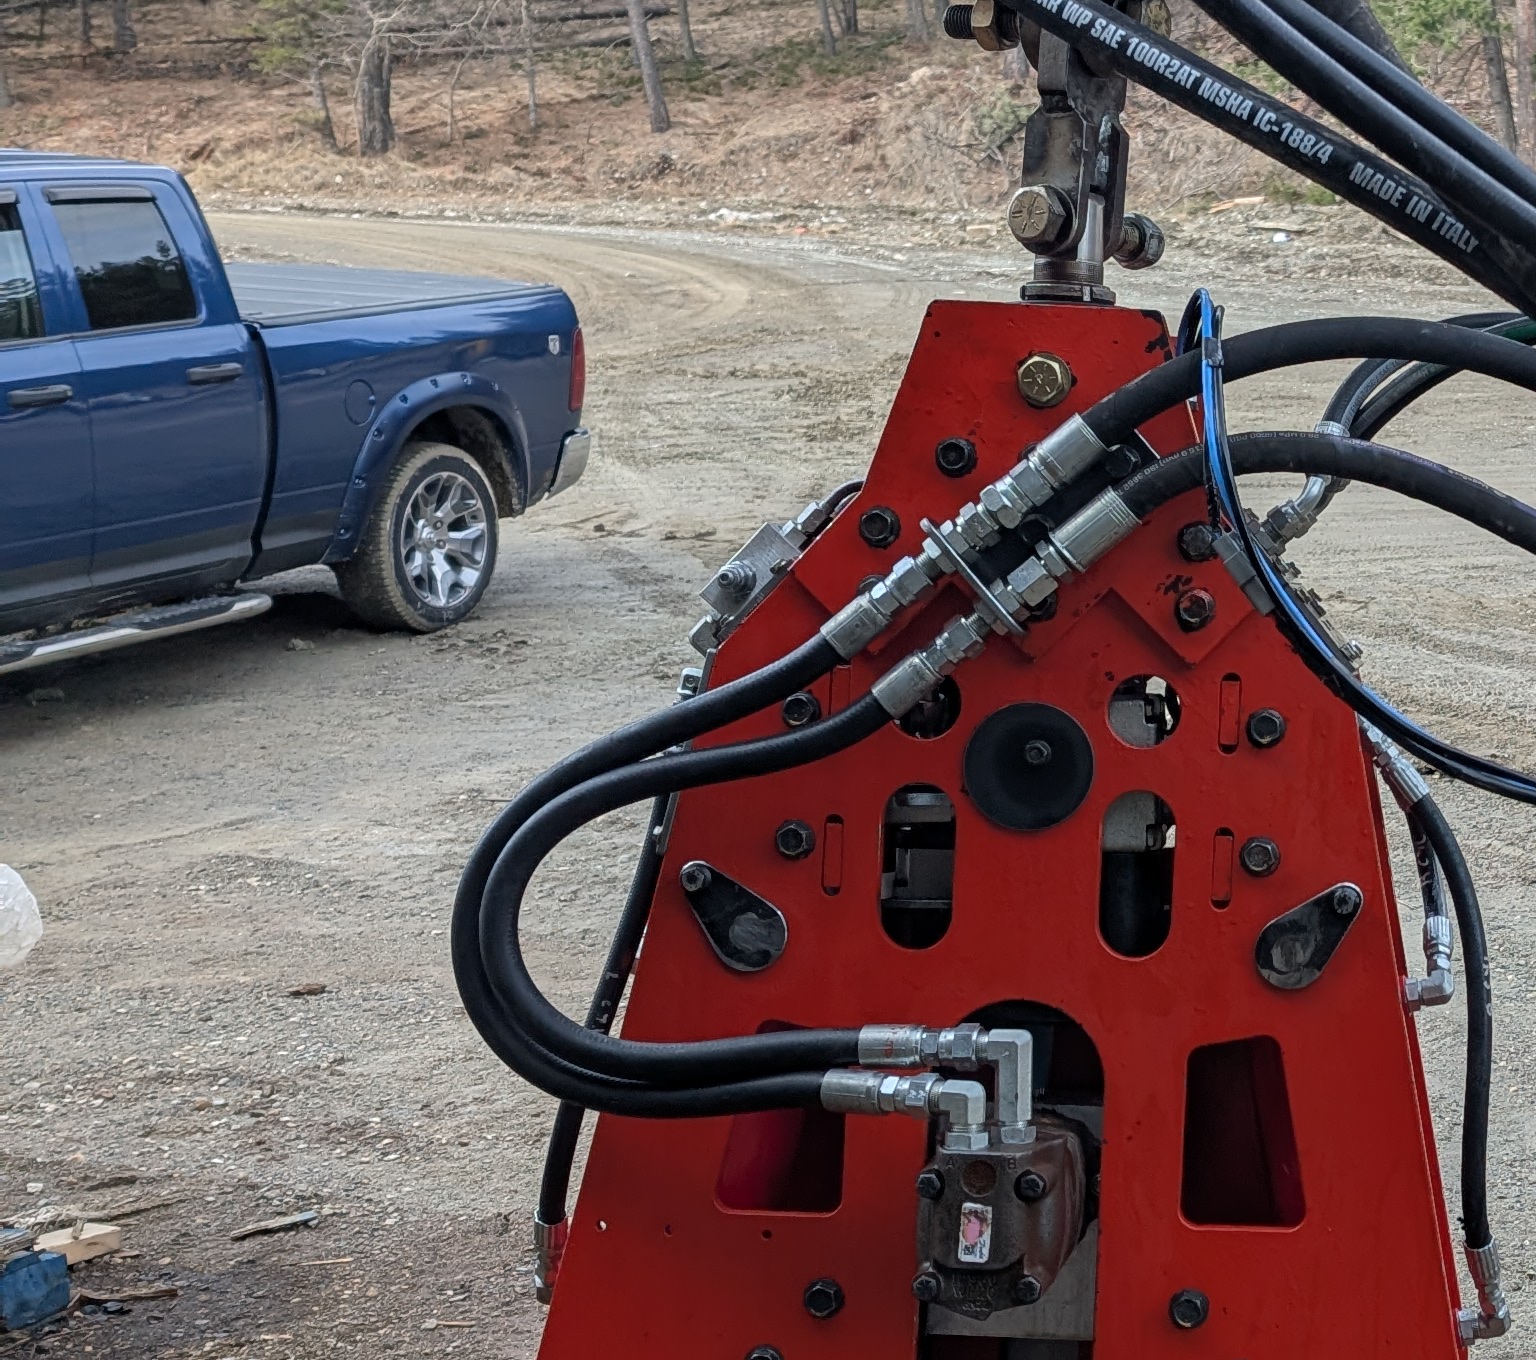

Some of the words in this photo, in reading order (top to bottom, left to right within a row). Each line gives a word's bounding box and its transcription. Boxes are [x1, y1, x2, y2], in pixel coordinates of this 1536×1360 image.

[1062, 0, 1092, 29] WP
[1090, 16, 1127, 49] SAE
[1126, 36, 1201, 90] 100R2AT
[1198, 78, 1253, 121] MSHA
[1252, 106, 1334, 165] IC-188/4
[1348, 161, 1406, 210] MADE
[1405, 194, 1433, 224] IN
[1430, 209, 1480, 254] ITALY
